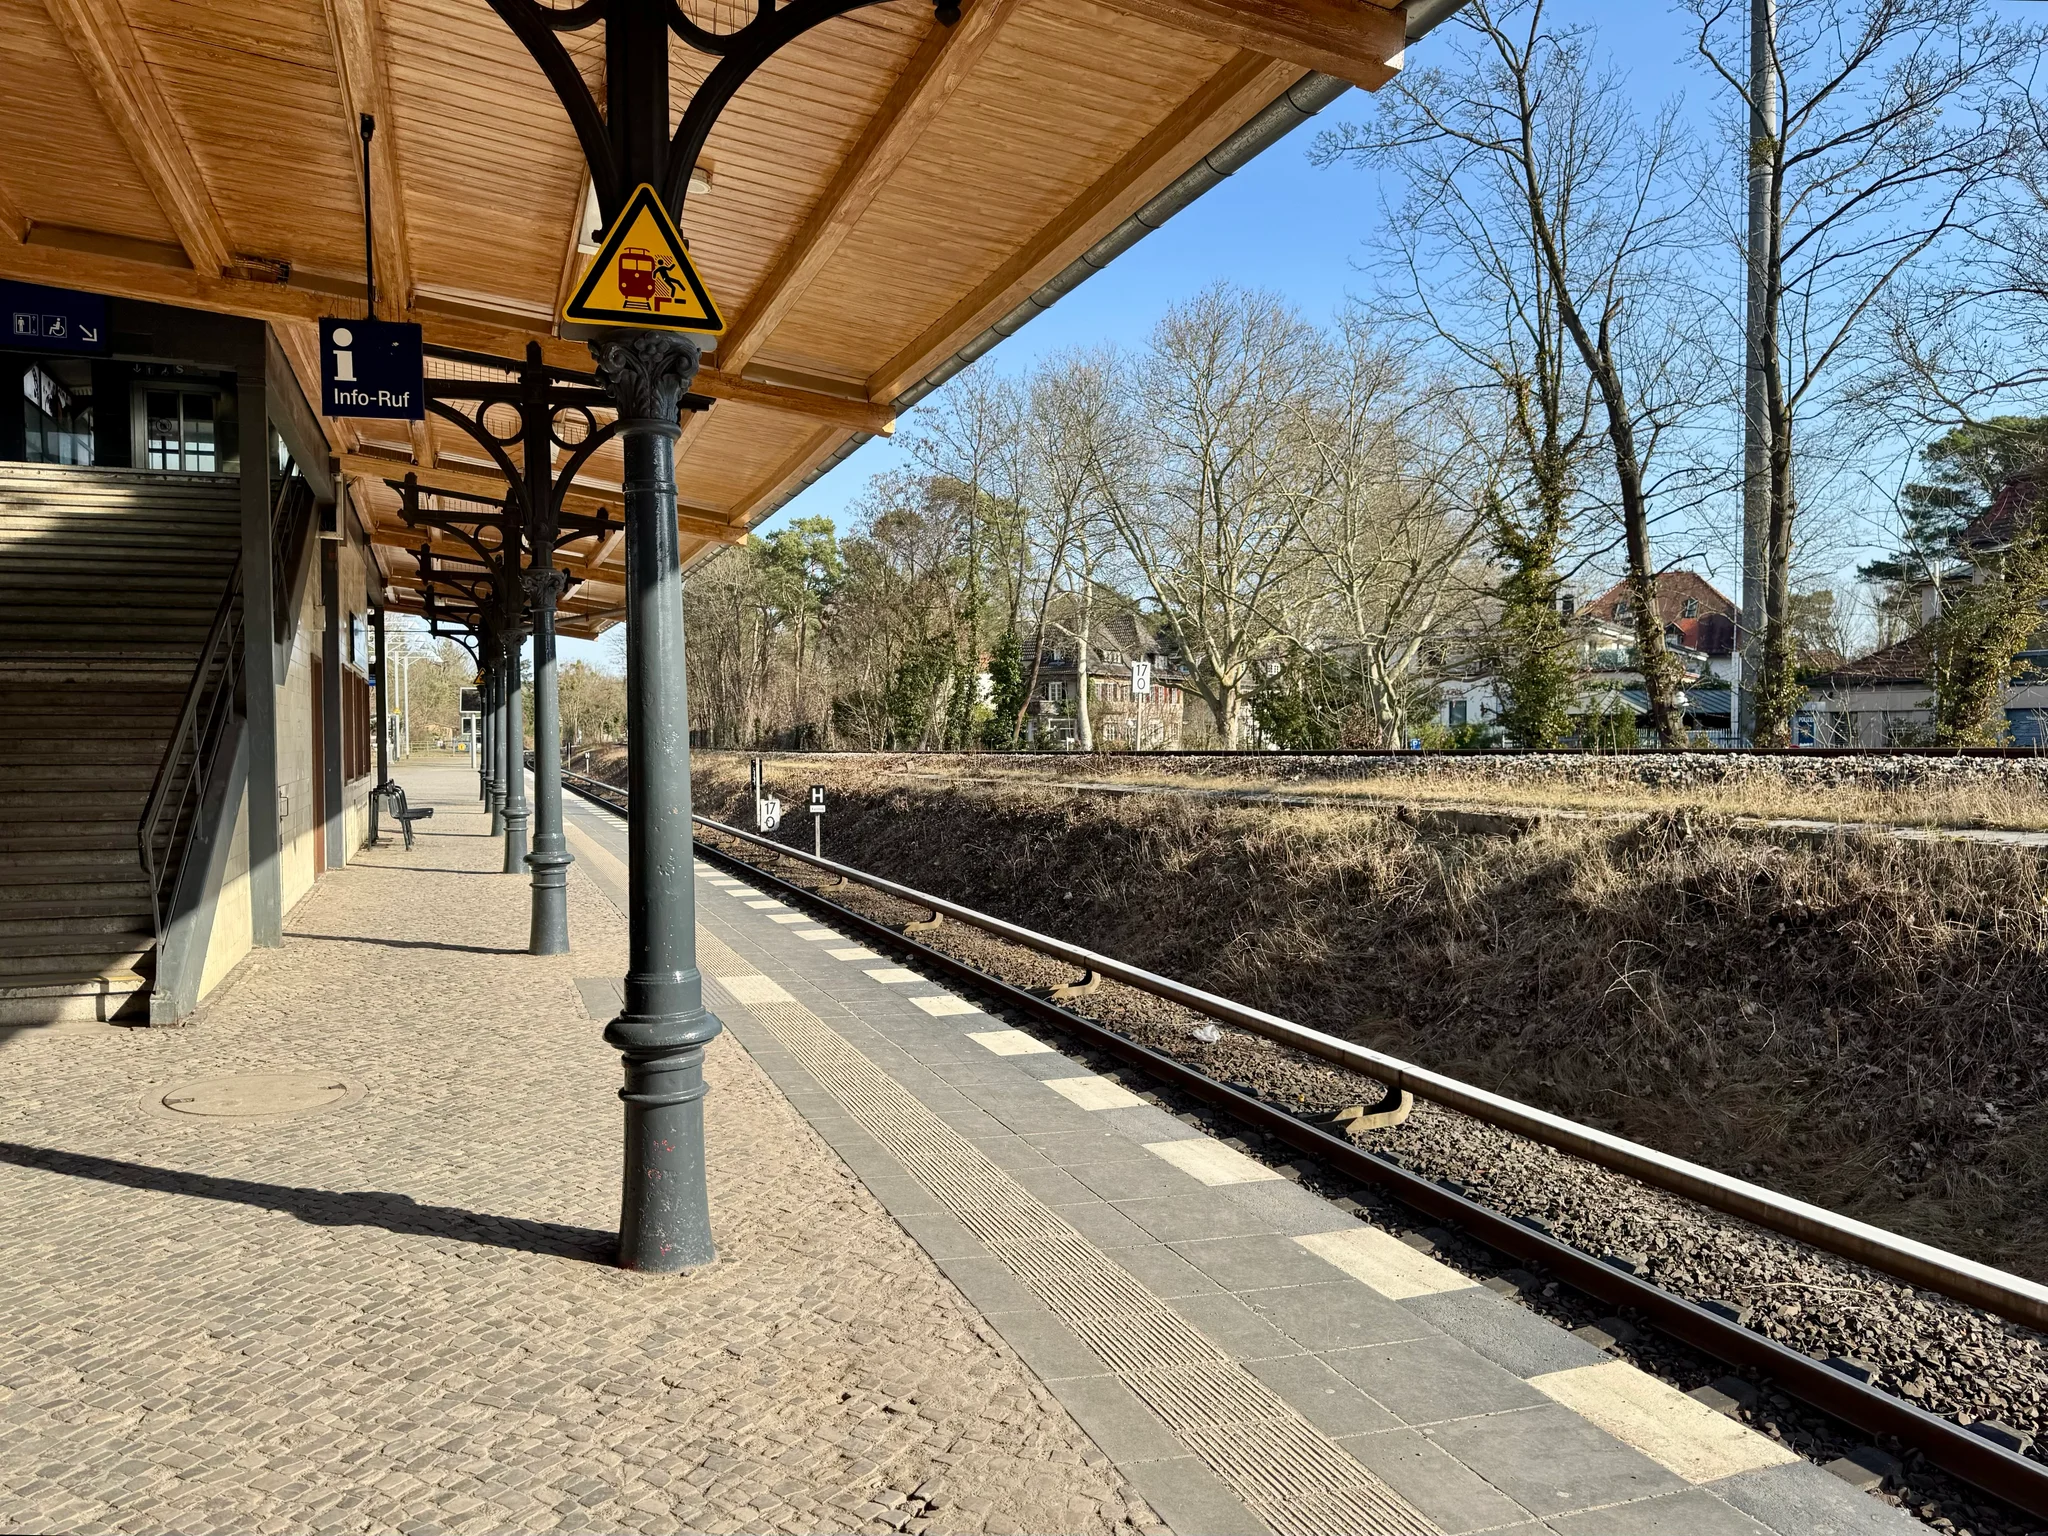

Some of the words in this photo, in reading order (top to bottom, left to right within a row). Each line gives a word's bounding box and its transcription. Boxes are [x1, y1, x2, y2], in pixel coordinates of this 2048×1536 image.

[334, 387, 410, 408] Info-Ruf
[1136, 664, 1148, 677] 17
[1137, 677, 1146, 690] 0
[812, 787, 824, 804] H
[764, 801, 776, 815] 17
[765, 816, 775, 829] 0
